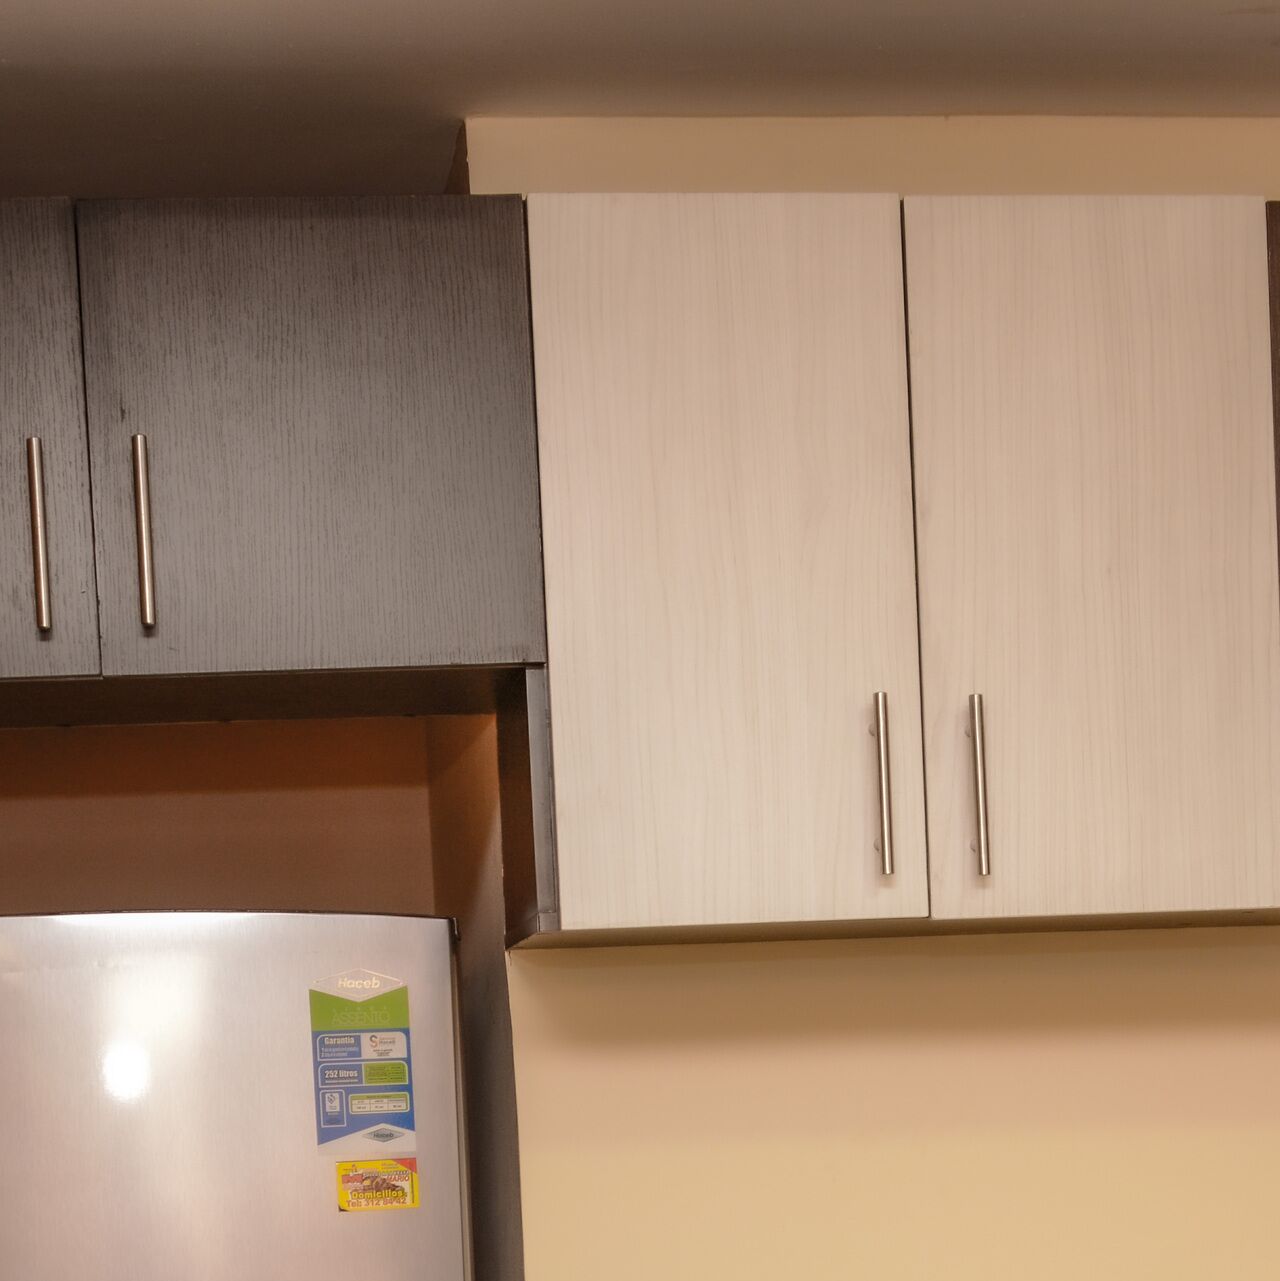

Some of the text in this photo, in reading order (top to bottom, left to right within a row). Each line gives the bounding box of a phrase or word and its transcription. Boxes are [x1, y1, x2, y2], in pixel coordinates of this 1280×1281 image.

[337, 976, 381, 989] Haceb
[331, 1010, 391, 1025] ASSENTO
[324, 1070, 338, 1078] 252
[339, 1069, 358, 1078] litros
[364, 1199, 381, 1207] 312
